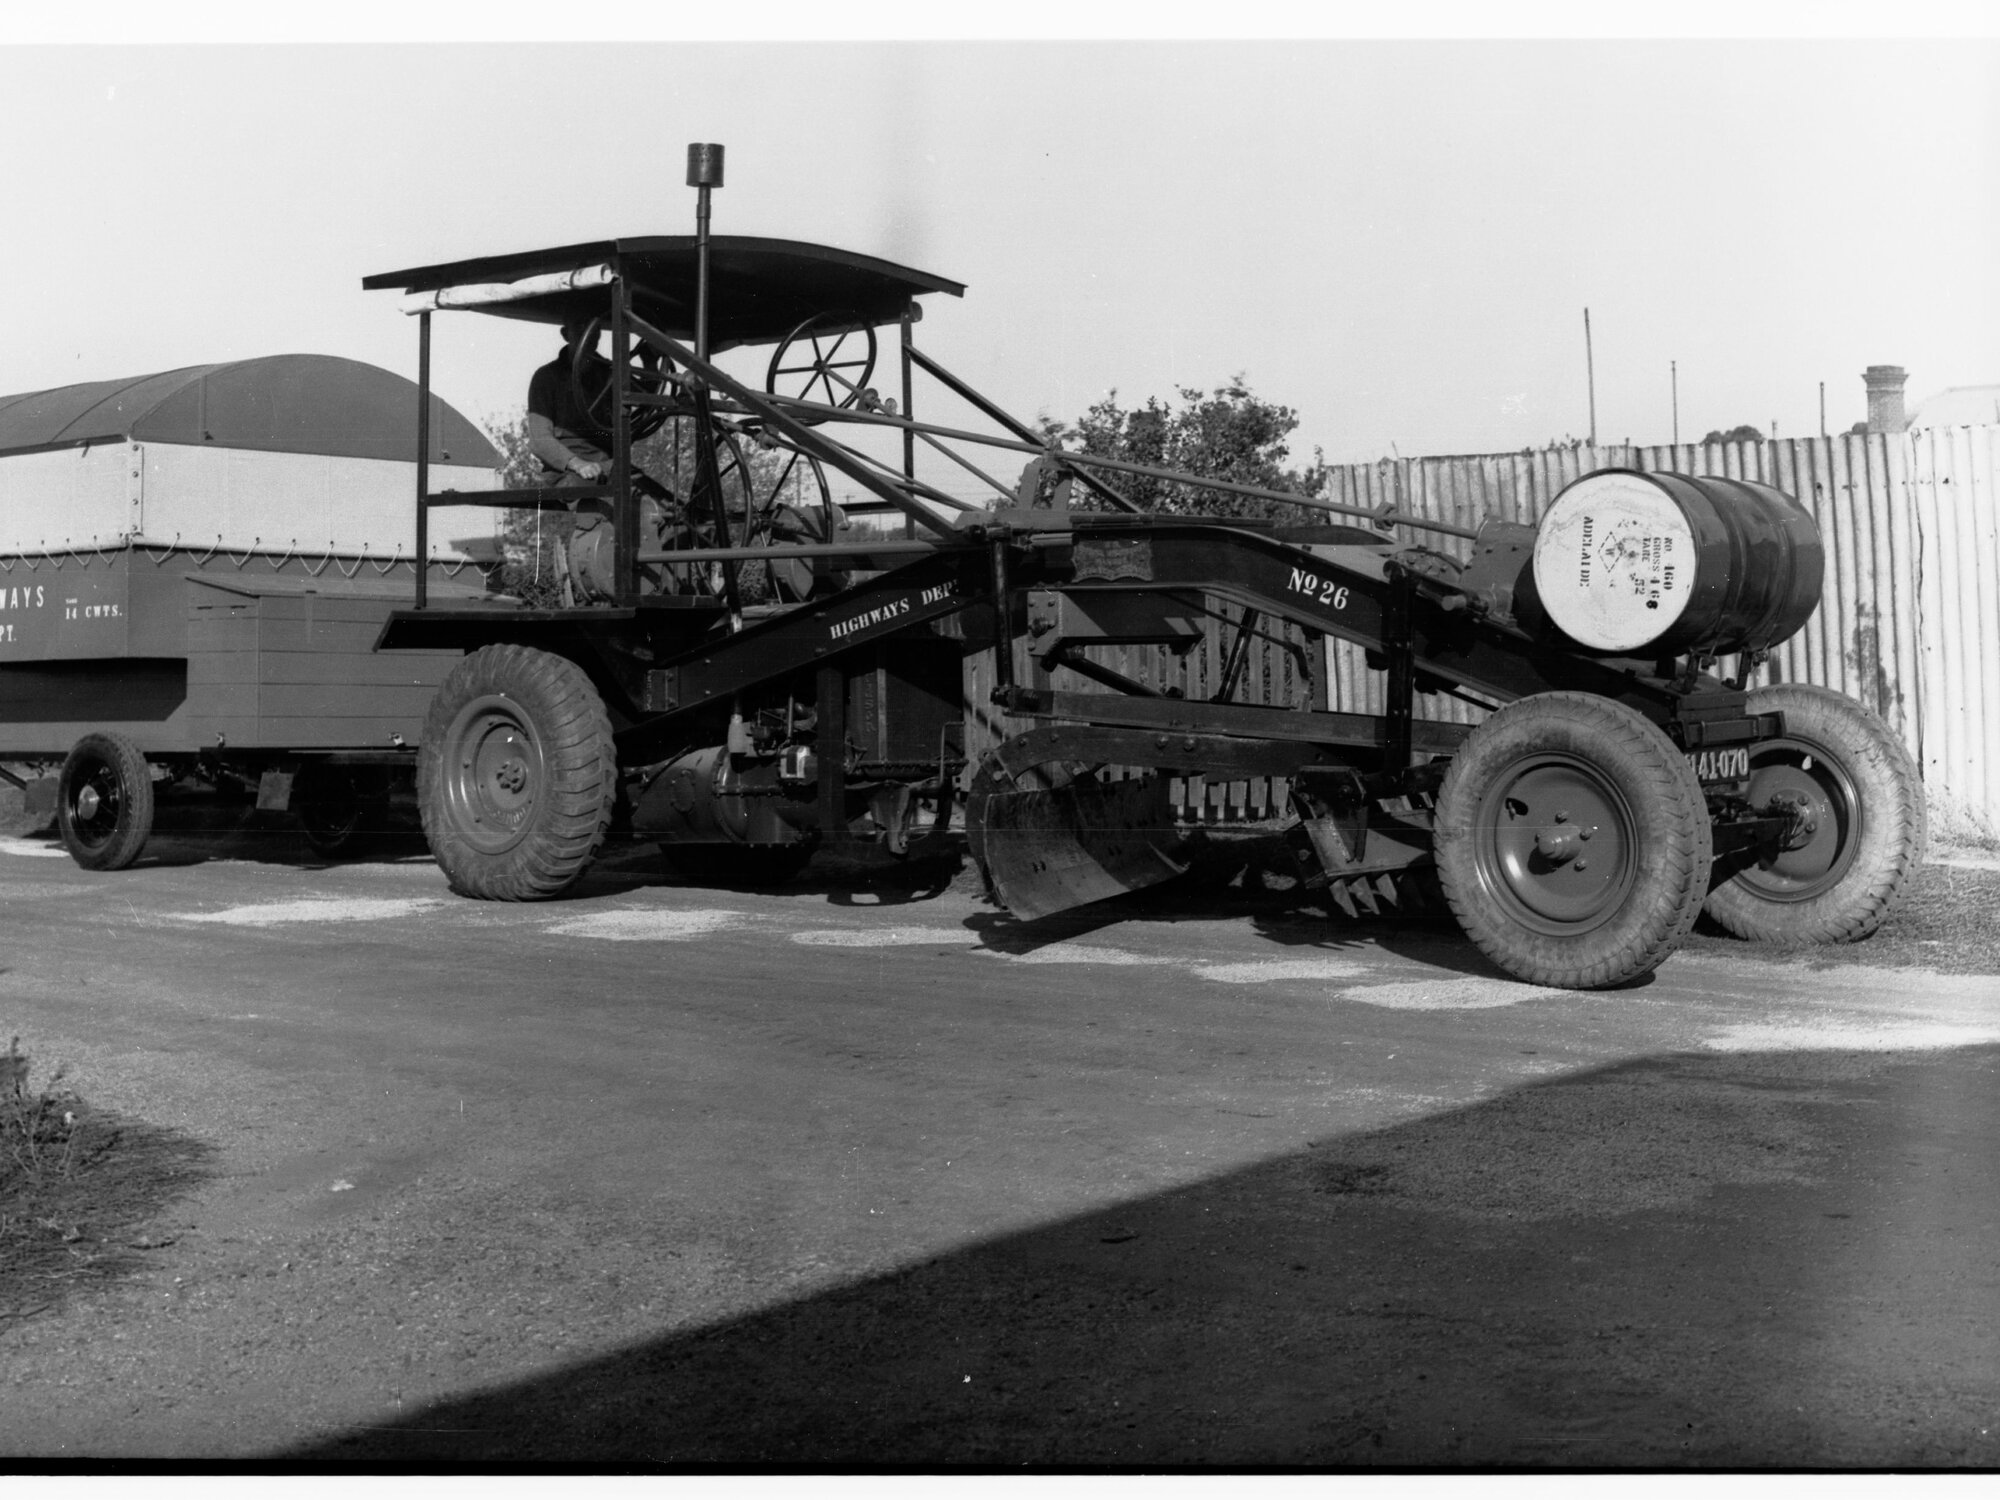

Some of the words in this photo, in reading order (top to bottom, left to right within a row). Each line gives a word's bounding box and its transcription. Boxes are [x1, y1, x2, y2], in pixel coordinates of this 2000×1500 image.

[1580, 516, 1593, 587] ADELAIDE
[1642, 537, 1651, 563] TARE
[1652, 537, 1661, 572] GROSS
[1319, 580, 1349, 610] 26
[65, 607, 78, 620] 14
[830, 597, 910, 640] HIGHWAYS
